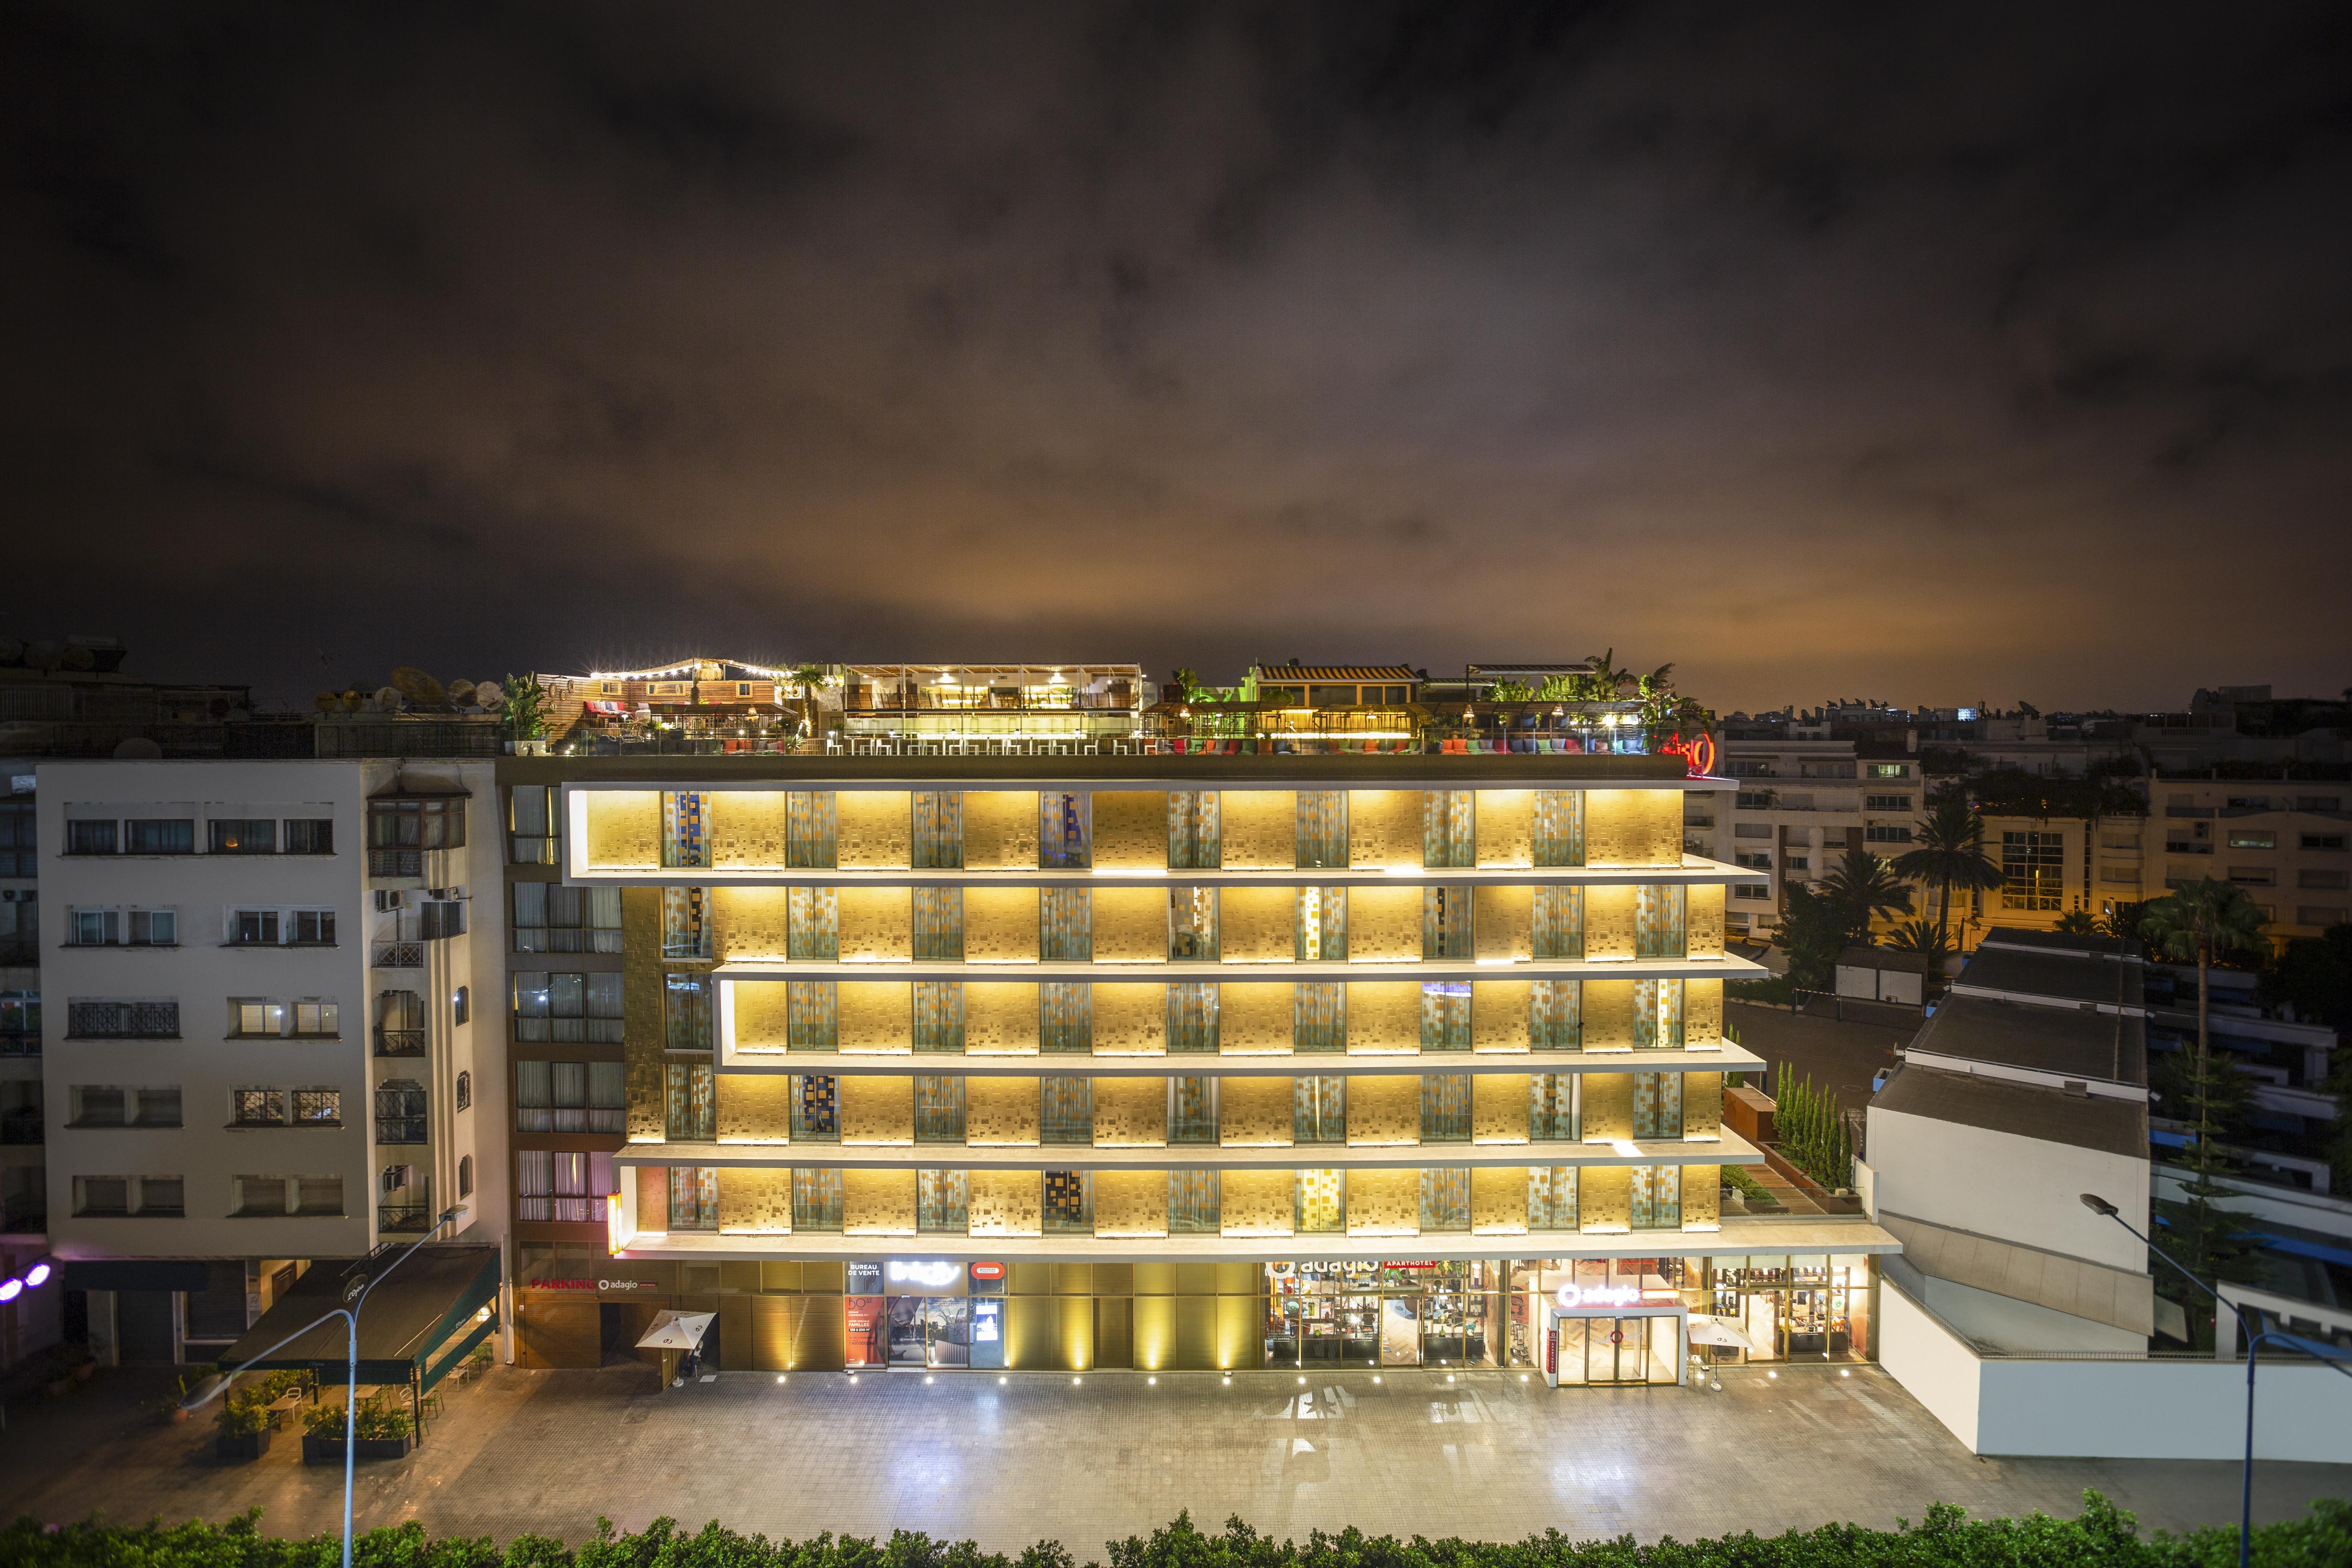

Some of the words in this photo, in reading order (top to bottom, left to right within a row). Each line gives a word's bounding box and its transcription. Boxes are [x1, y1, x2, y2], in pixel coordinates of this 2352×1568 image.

[531, 1278, 595, 1290] PARKING
[610, 1279, 638, 1290] adagio
[1582, 1284, 1640, 1306] adagio
